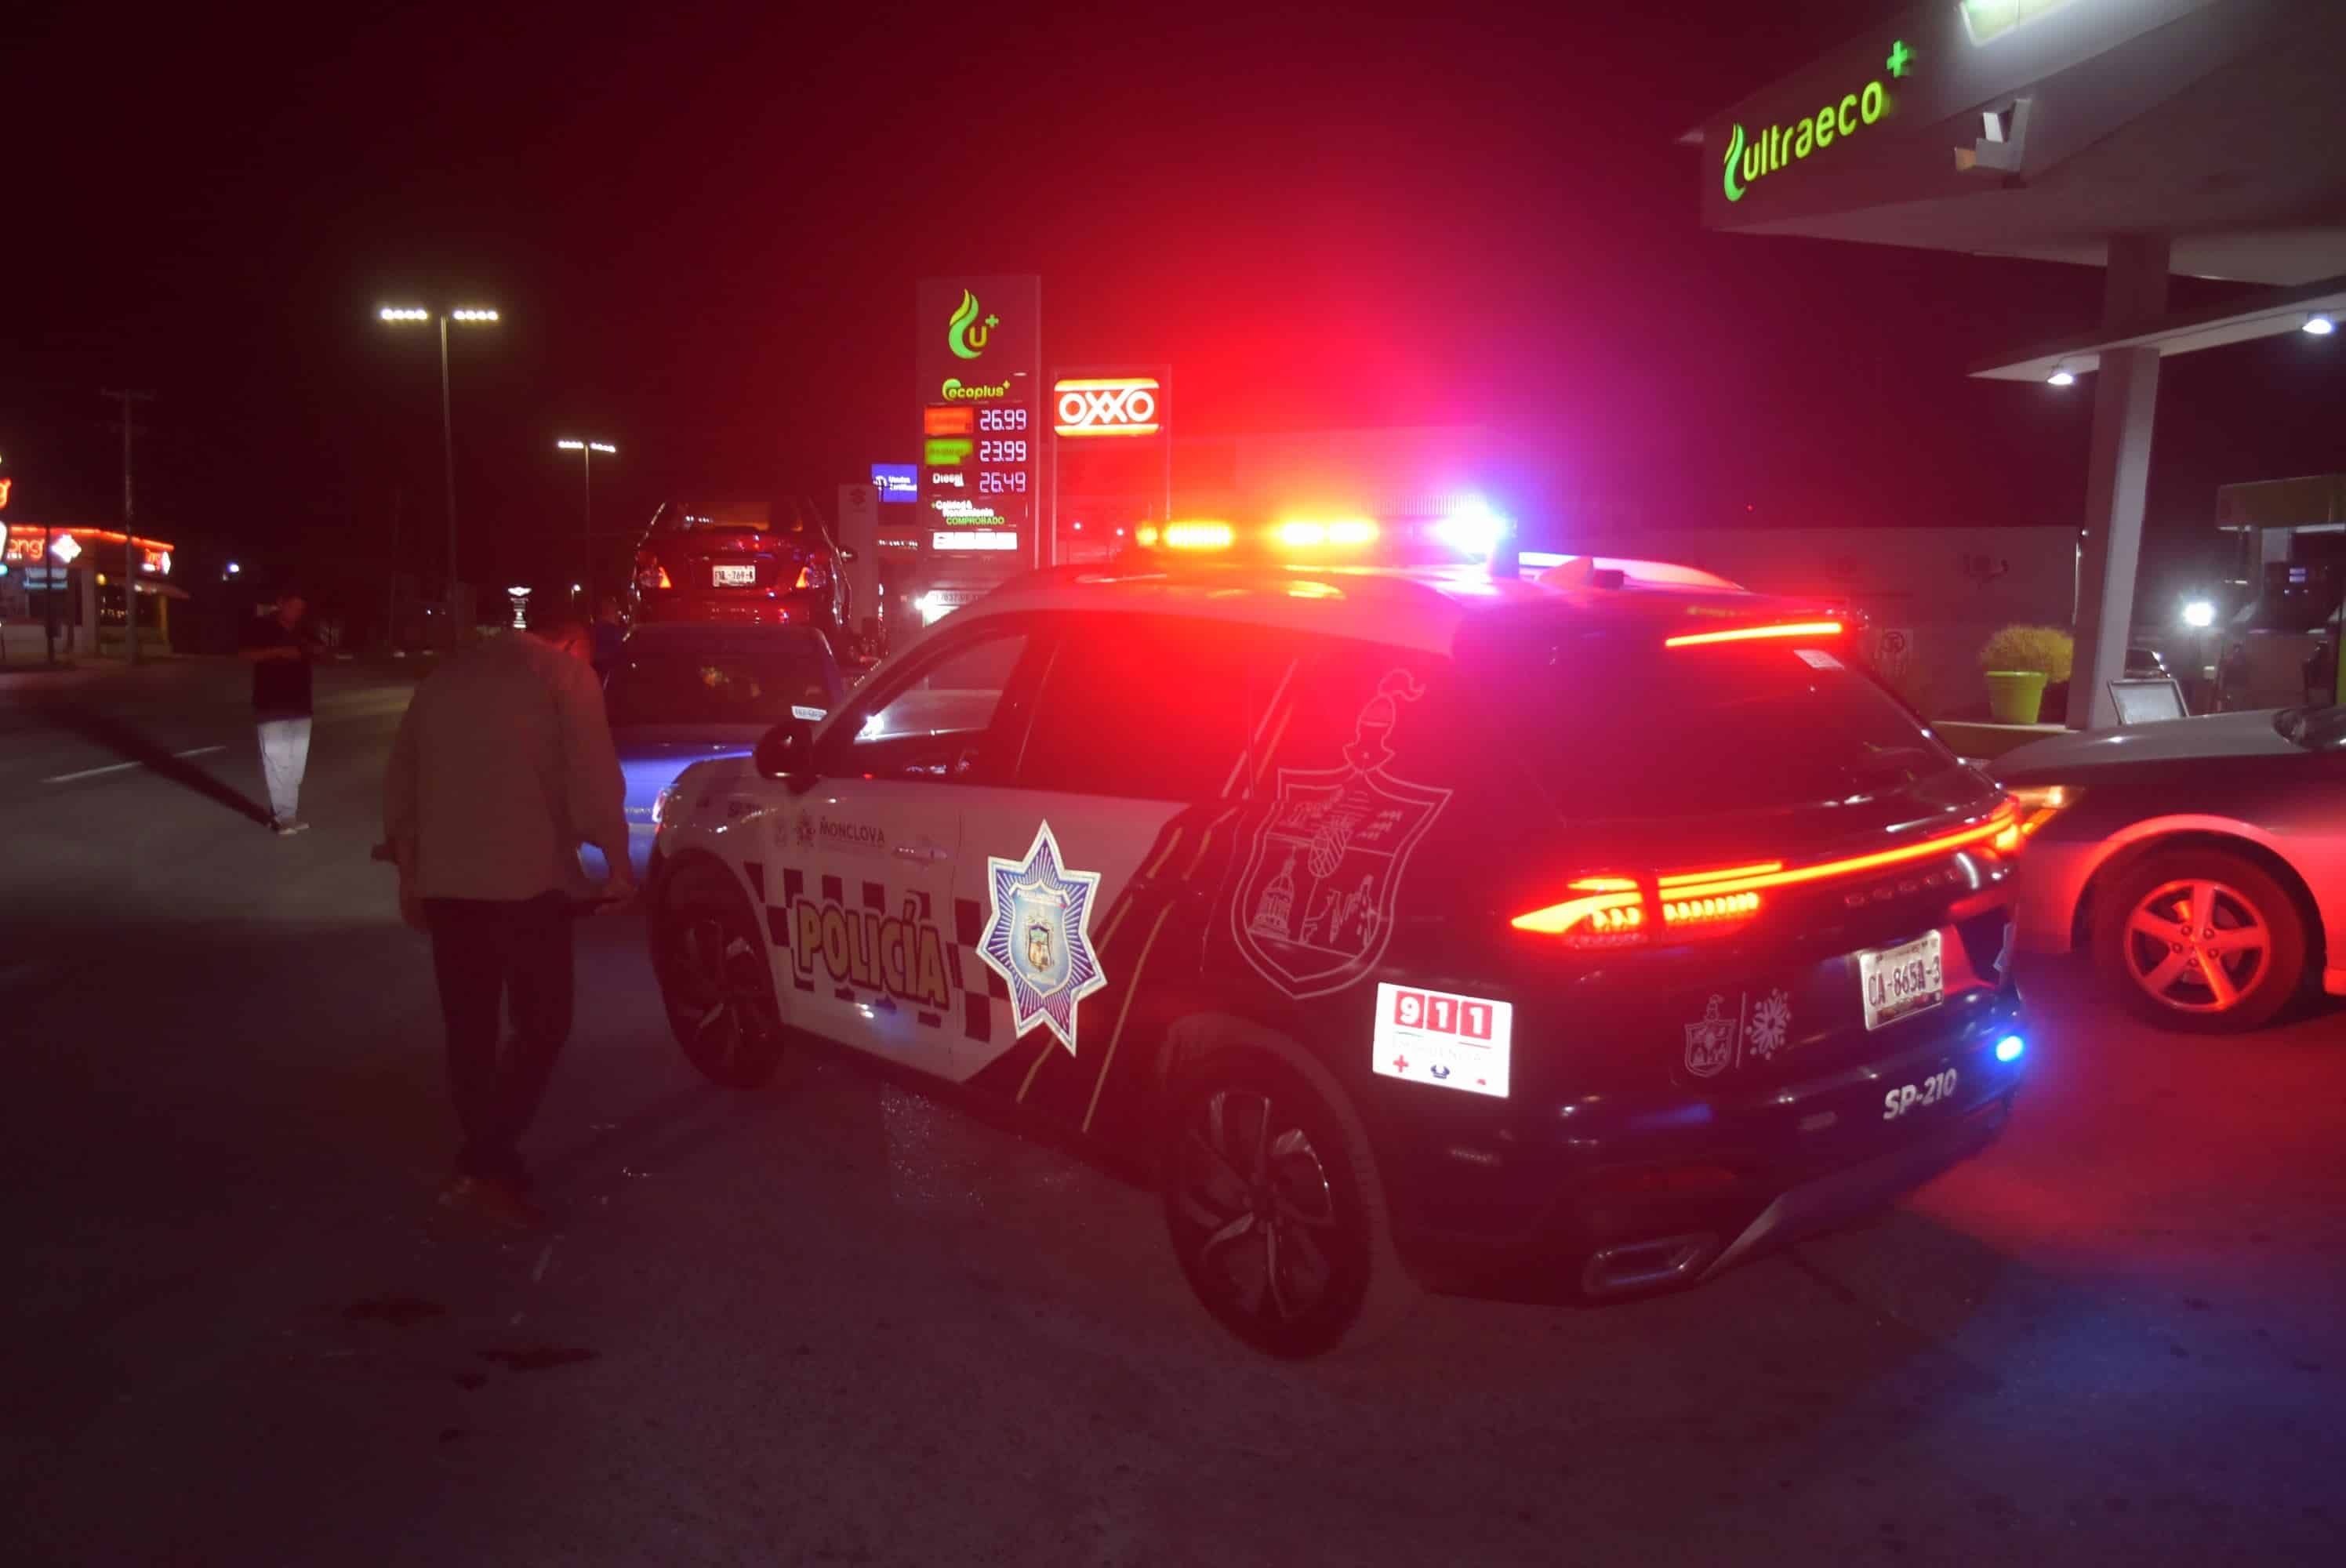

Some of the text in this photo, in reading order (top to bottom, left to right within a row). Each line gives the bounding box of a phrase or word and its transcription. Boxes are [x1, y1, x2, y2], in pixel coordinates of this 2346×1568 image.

[1059, 388, 1154, 427] OXXO
[946, 516, 1004, 525] COMPROBADO
[797, 900, 950, 1011] POLICÍA
[1883, 1067, 1957, 1120] SP-210
